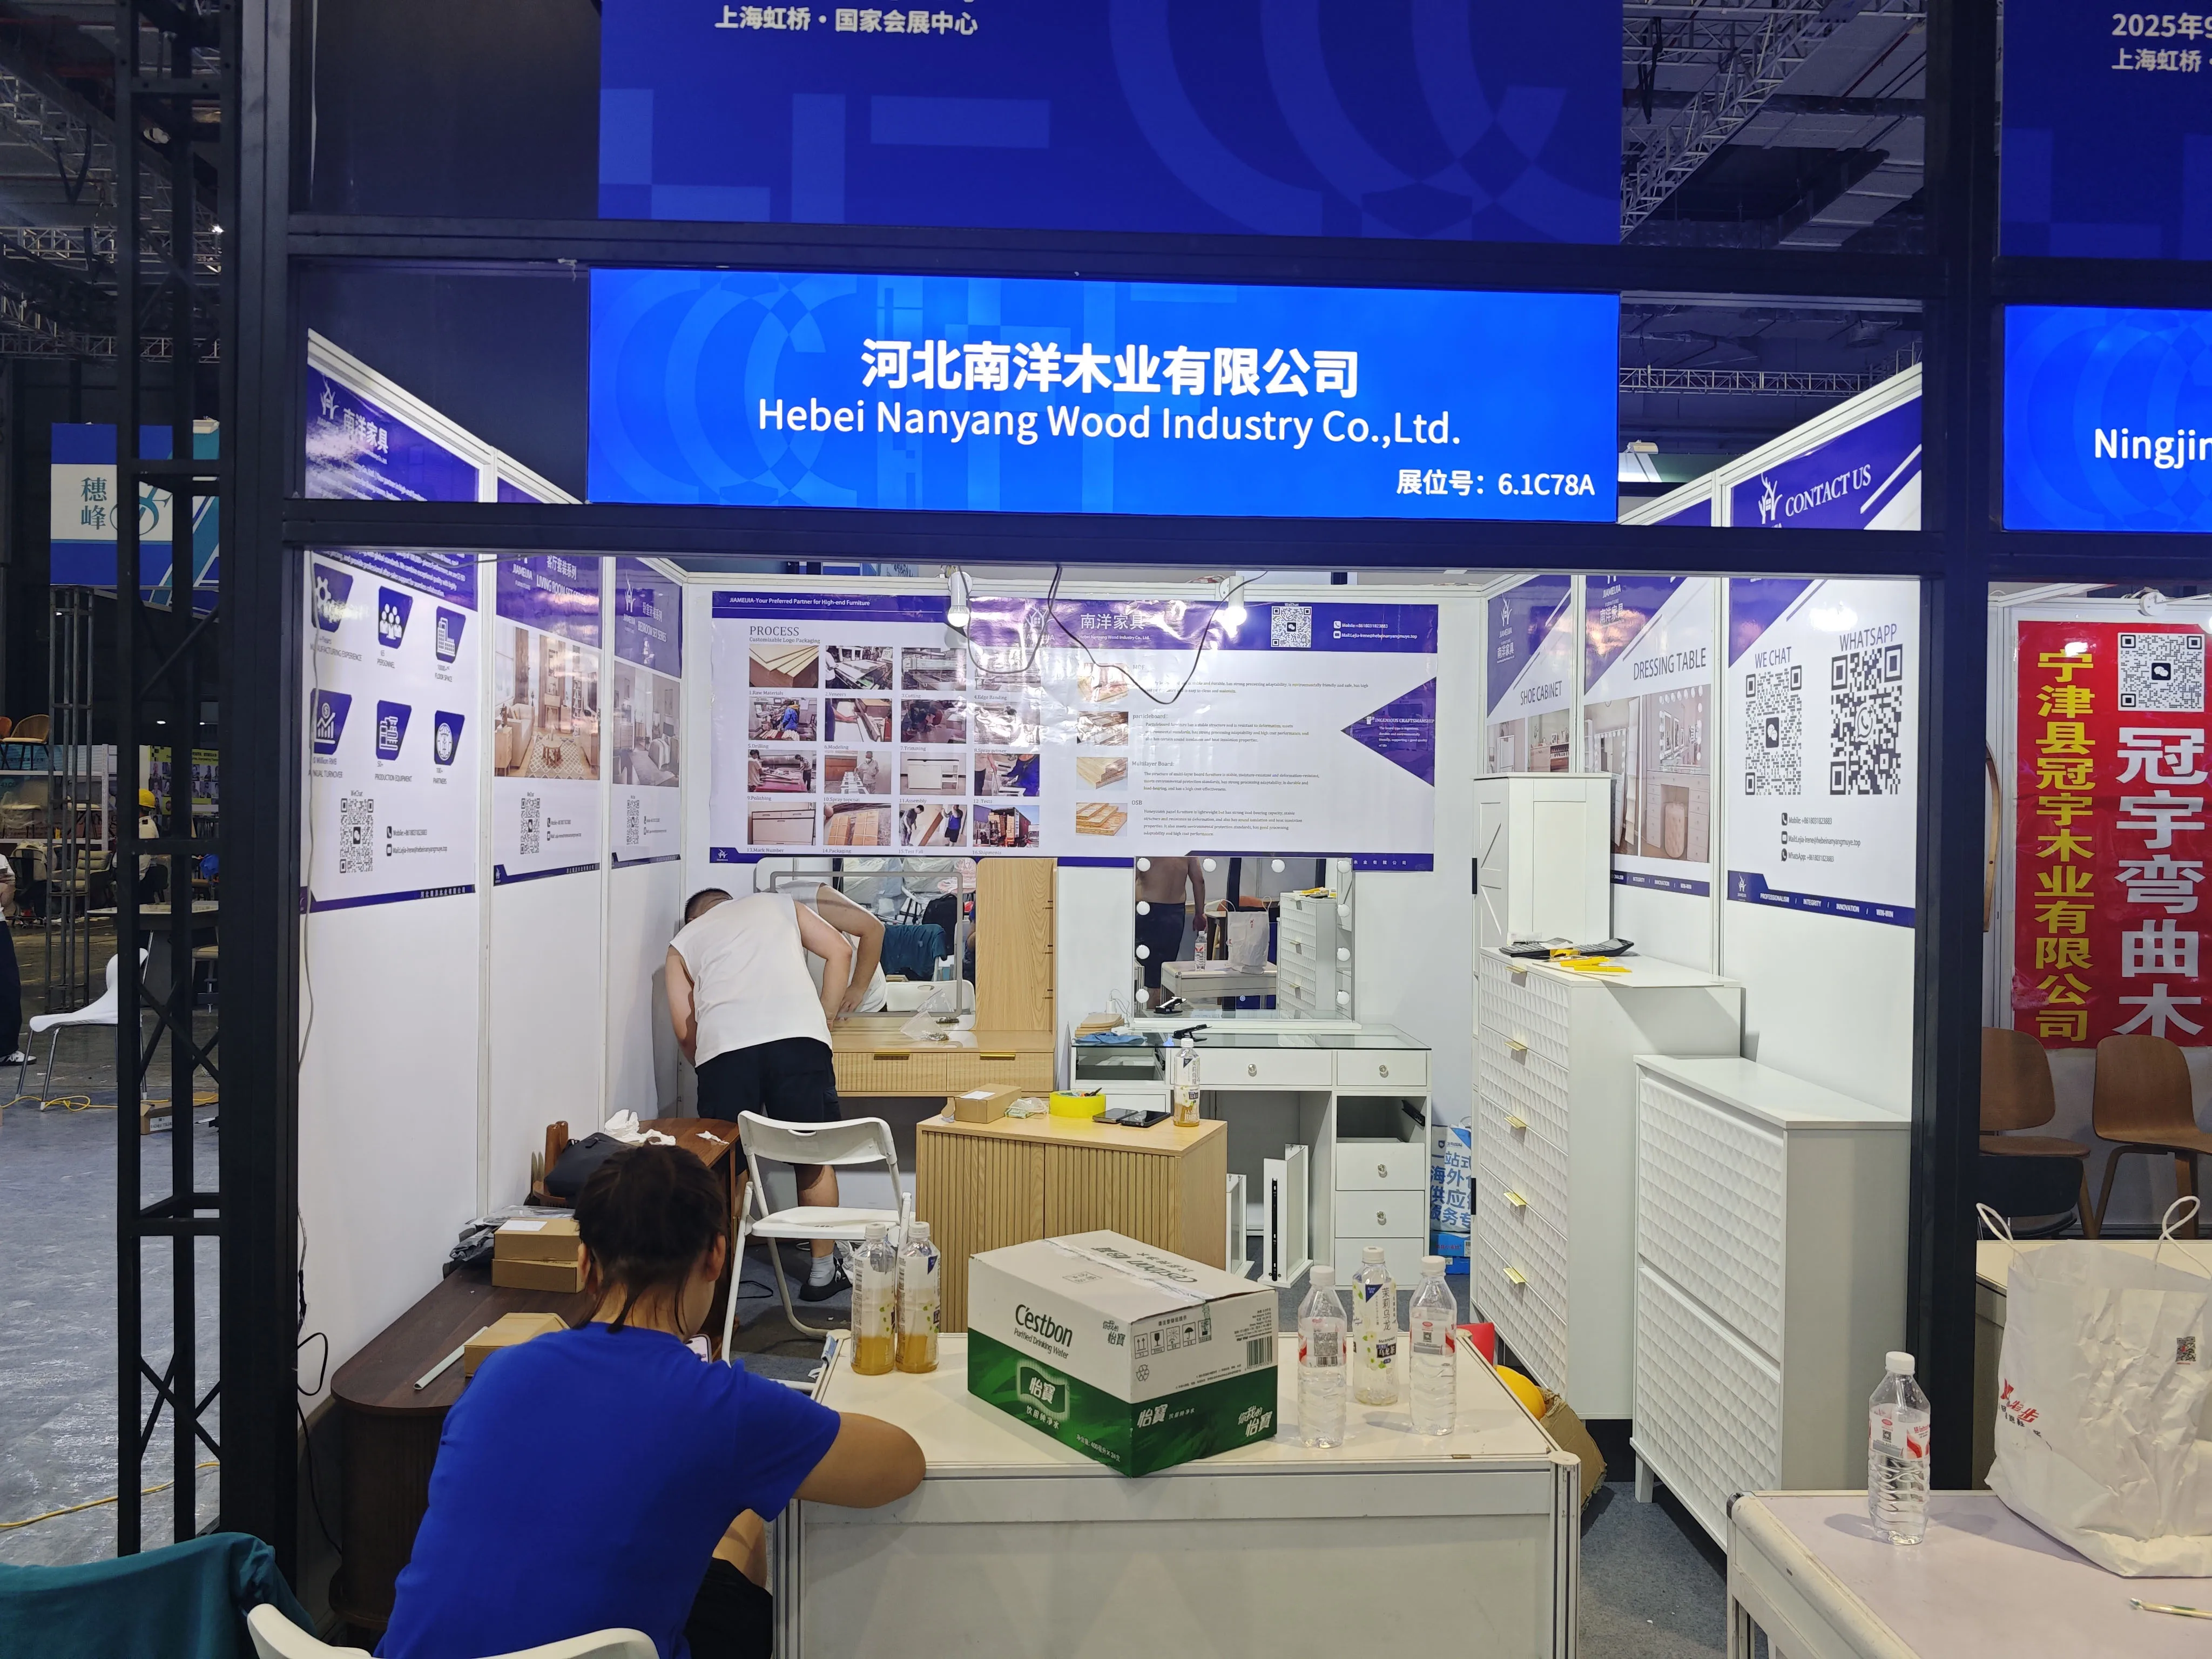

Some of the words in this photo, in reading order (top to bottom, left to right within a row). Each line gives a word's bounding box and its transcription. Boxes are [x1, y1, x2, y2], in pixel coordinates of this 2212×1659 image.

[714, 5, 978, 35] 上海虹桥·国家会展中心
[861, 338, 1358, 398] 河北南洋木业有限公司
[343, 408, 388, 454] 南洋家具
[759, 398, 865, 432] Hebei
[878, 401, 1038, 445] Nanyang
[1047, 404, 1150, 439] Wood
[1163, 406, 1313, 449] Industry
[1323, 410, 1460, 449] Co.,Ltd.
[81, 477, 107, 530] 穗峰
[1786, 481, 1849, 517] CONTACT
[1853, 464, 1871, 494] US
[536, 575, 552, 592] LIVING
[552, 582, 565, 595] ROOM
[1080, 613, 1145, 630] 南洋家具
[1600, 603, 1623, 624] 南洋家具
[750, 626, 799, 636] PROCESS
[1839, 623, 1897, 652] WHATSAPP
[1634, 654, 1674, 680] DRESSING
[1677, 648, 1707, 671] TABLE
[1755, 651, 1767, 669] WE
[1769, 646, 1792, 666] CHAT
[1520, 688, 1535, 705] SHOE
[1536, 680, 1562, 700] CABINET
[2035, 649, 2095, 1042] 宁津县冠宇木业有限公司
[2112, 727, 2208, 1038] 冠宇弯曲木
[1803, 898, 1822, 907] INTEGRITY
[1431, 1184, 1471, 1210] 供应
[1033, 1336, 1053, 1354] Drinking
[1053, 1346, 1069, 1359] Water
[1029, 1377, 1056, 1404] 怡寶
[1137, 1404, 1168, 1428] 怡寶
[1245, 1411, 1273, 1438] 怡寶
